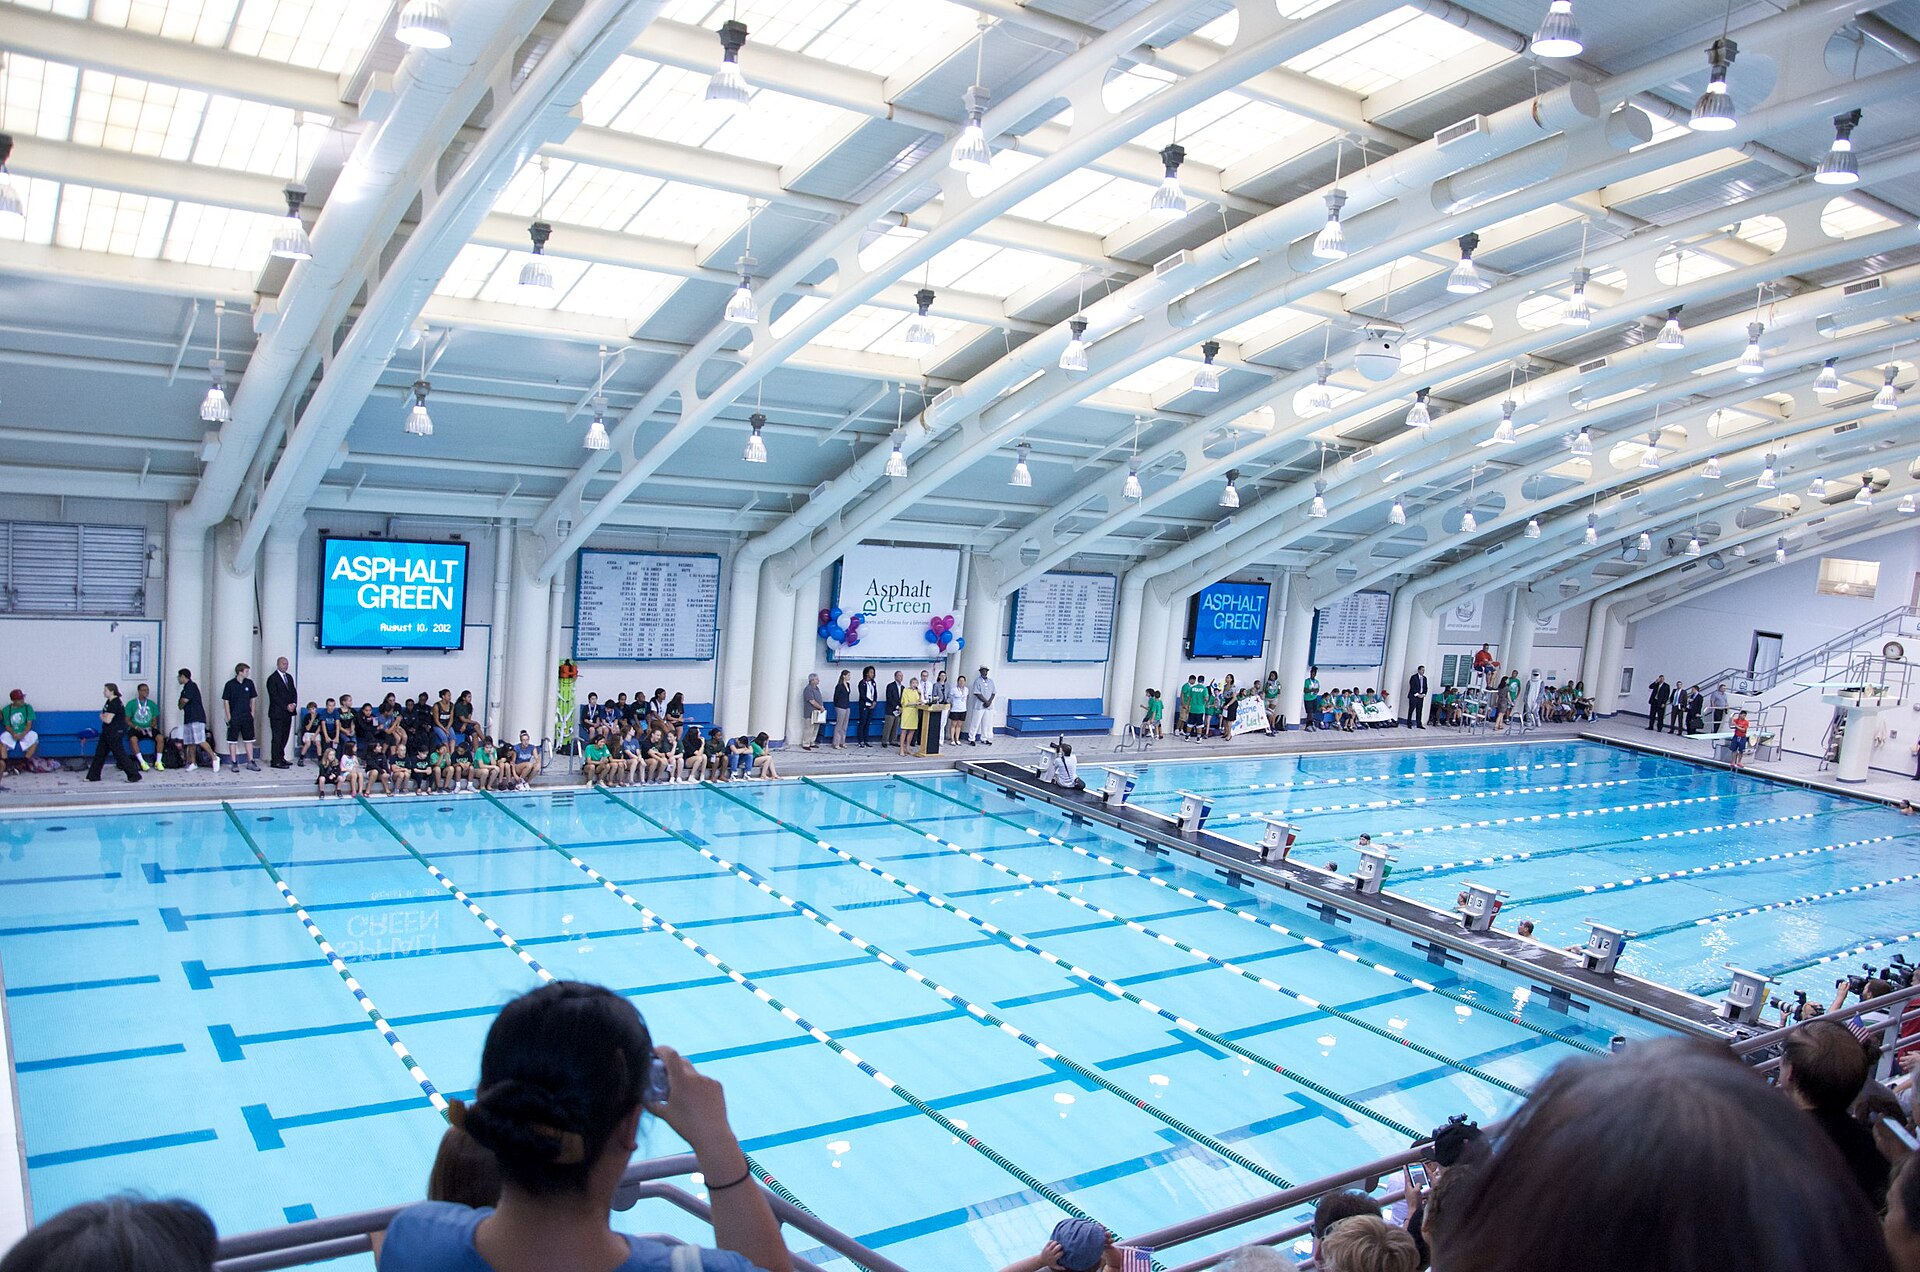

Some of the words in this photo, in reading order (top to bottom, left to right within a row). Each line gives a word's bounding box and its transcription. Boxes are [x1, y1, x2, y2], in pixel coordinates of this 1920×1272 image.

[331, 555, 459, 584] ASPHALT
[357, 583, 454, 610] GREEN
[864, 578, 932, 602] Asphalt
[880, 595, 931, 613] Green
[1202, 593, 1265, 612] ASPHALT
[380, 622, 412, 632] August
[416, 623, 429, 632] 10,
[432, 623, 452, 633] 2012
[1213, 612, 1261, 630] GREEN
[1237, 704, 1257, 715] elcome
[1476, 899, 1483, 907] 3
[1603, 940, 1610, 949] 2
